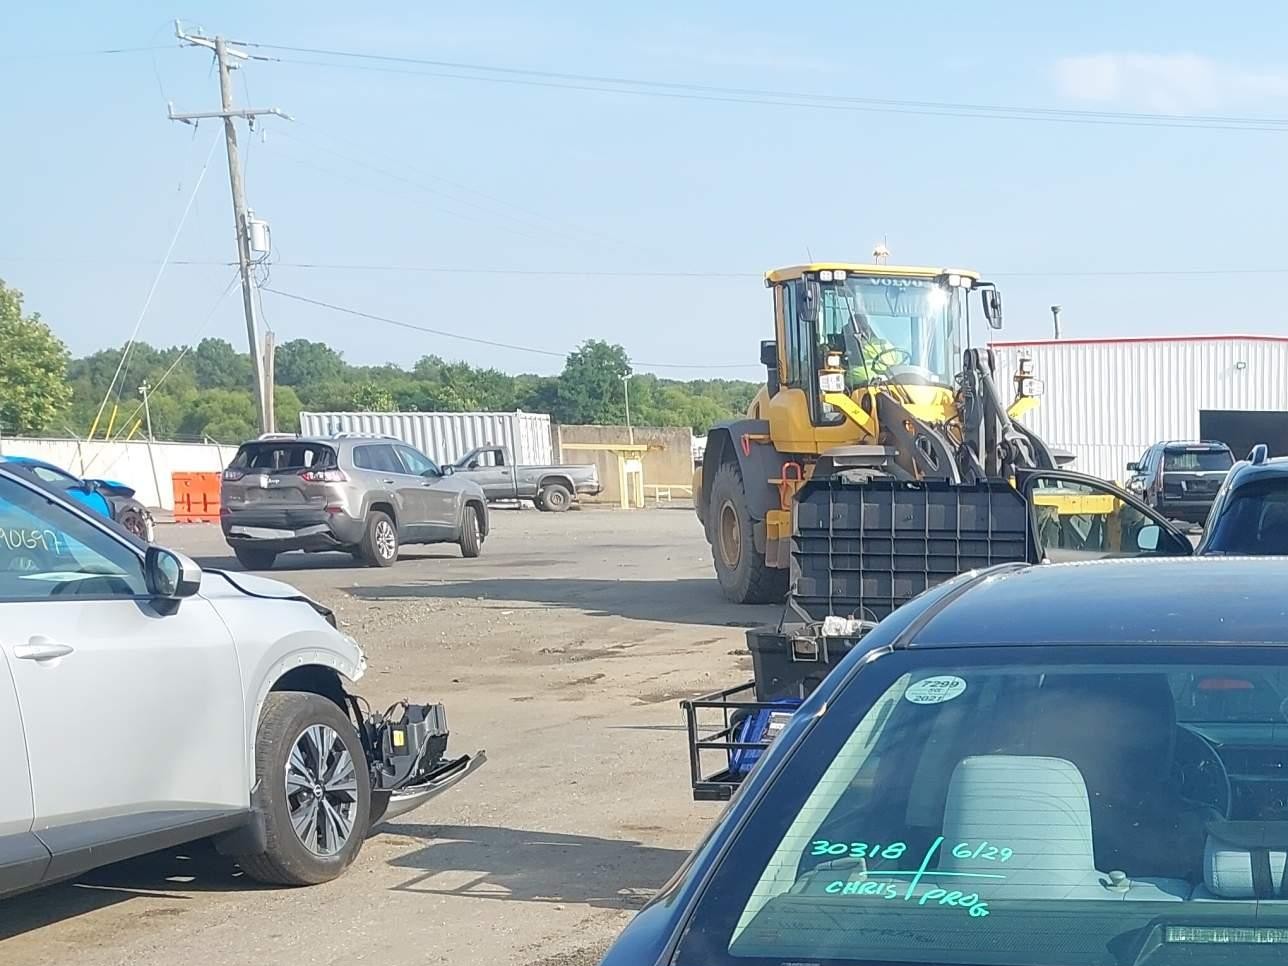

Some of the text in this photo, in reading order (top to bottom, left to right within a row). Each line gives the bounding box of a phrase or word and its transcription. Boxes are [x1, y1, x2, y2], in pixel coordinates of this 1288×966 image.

[871, 278, 923, 288] VOLVO
[811, 840, 1013, 862] 30318 6/29
[825, 880, 990, 917] CHRIS PROG
